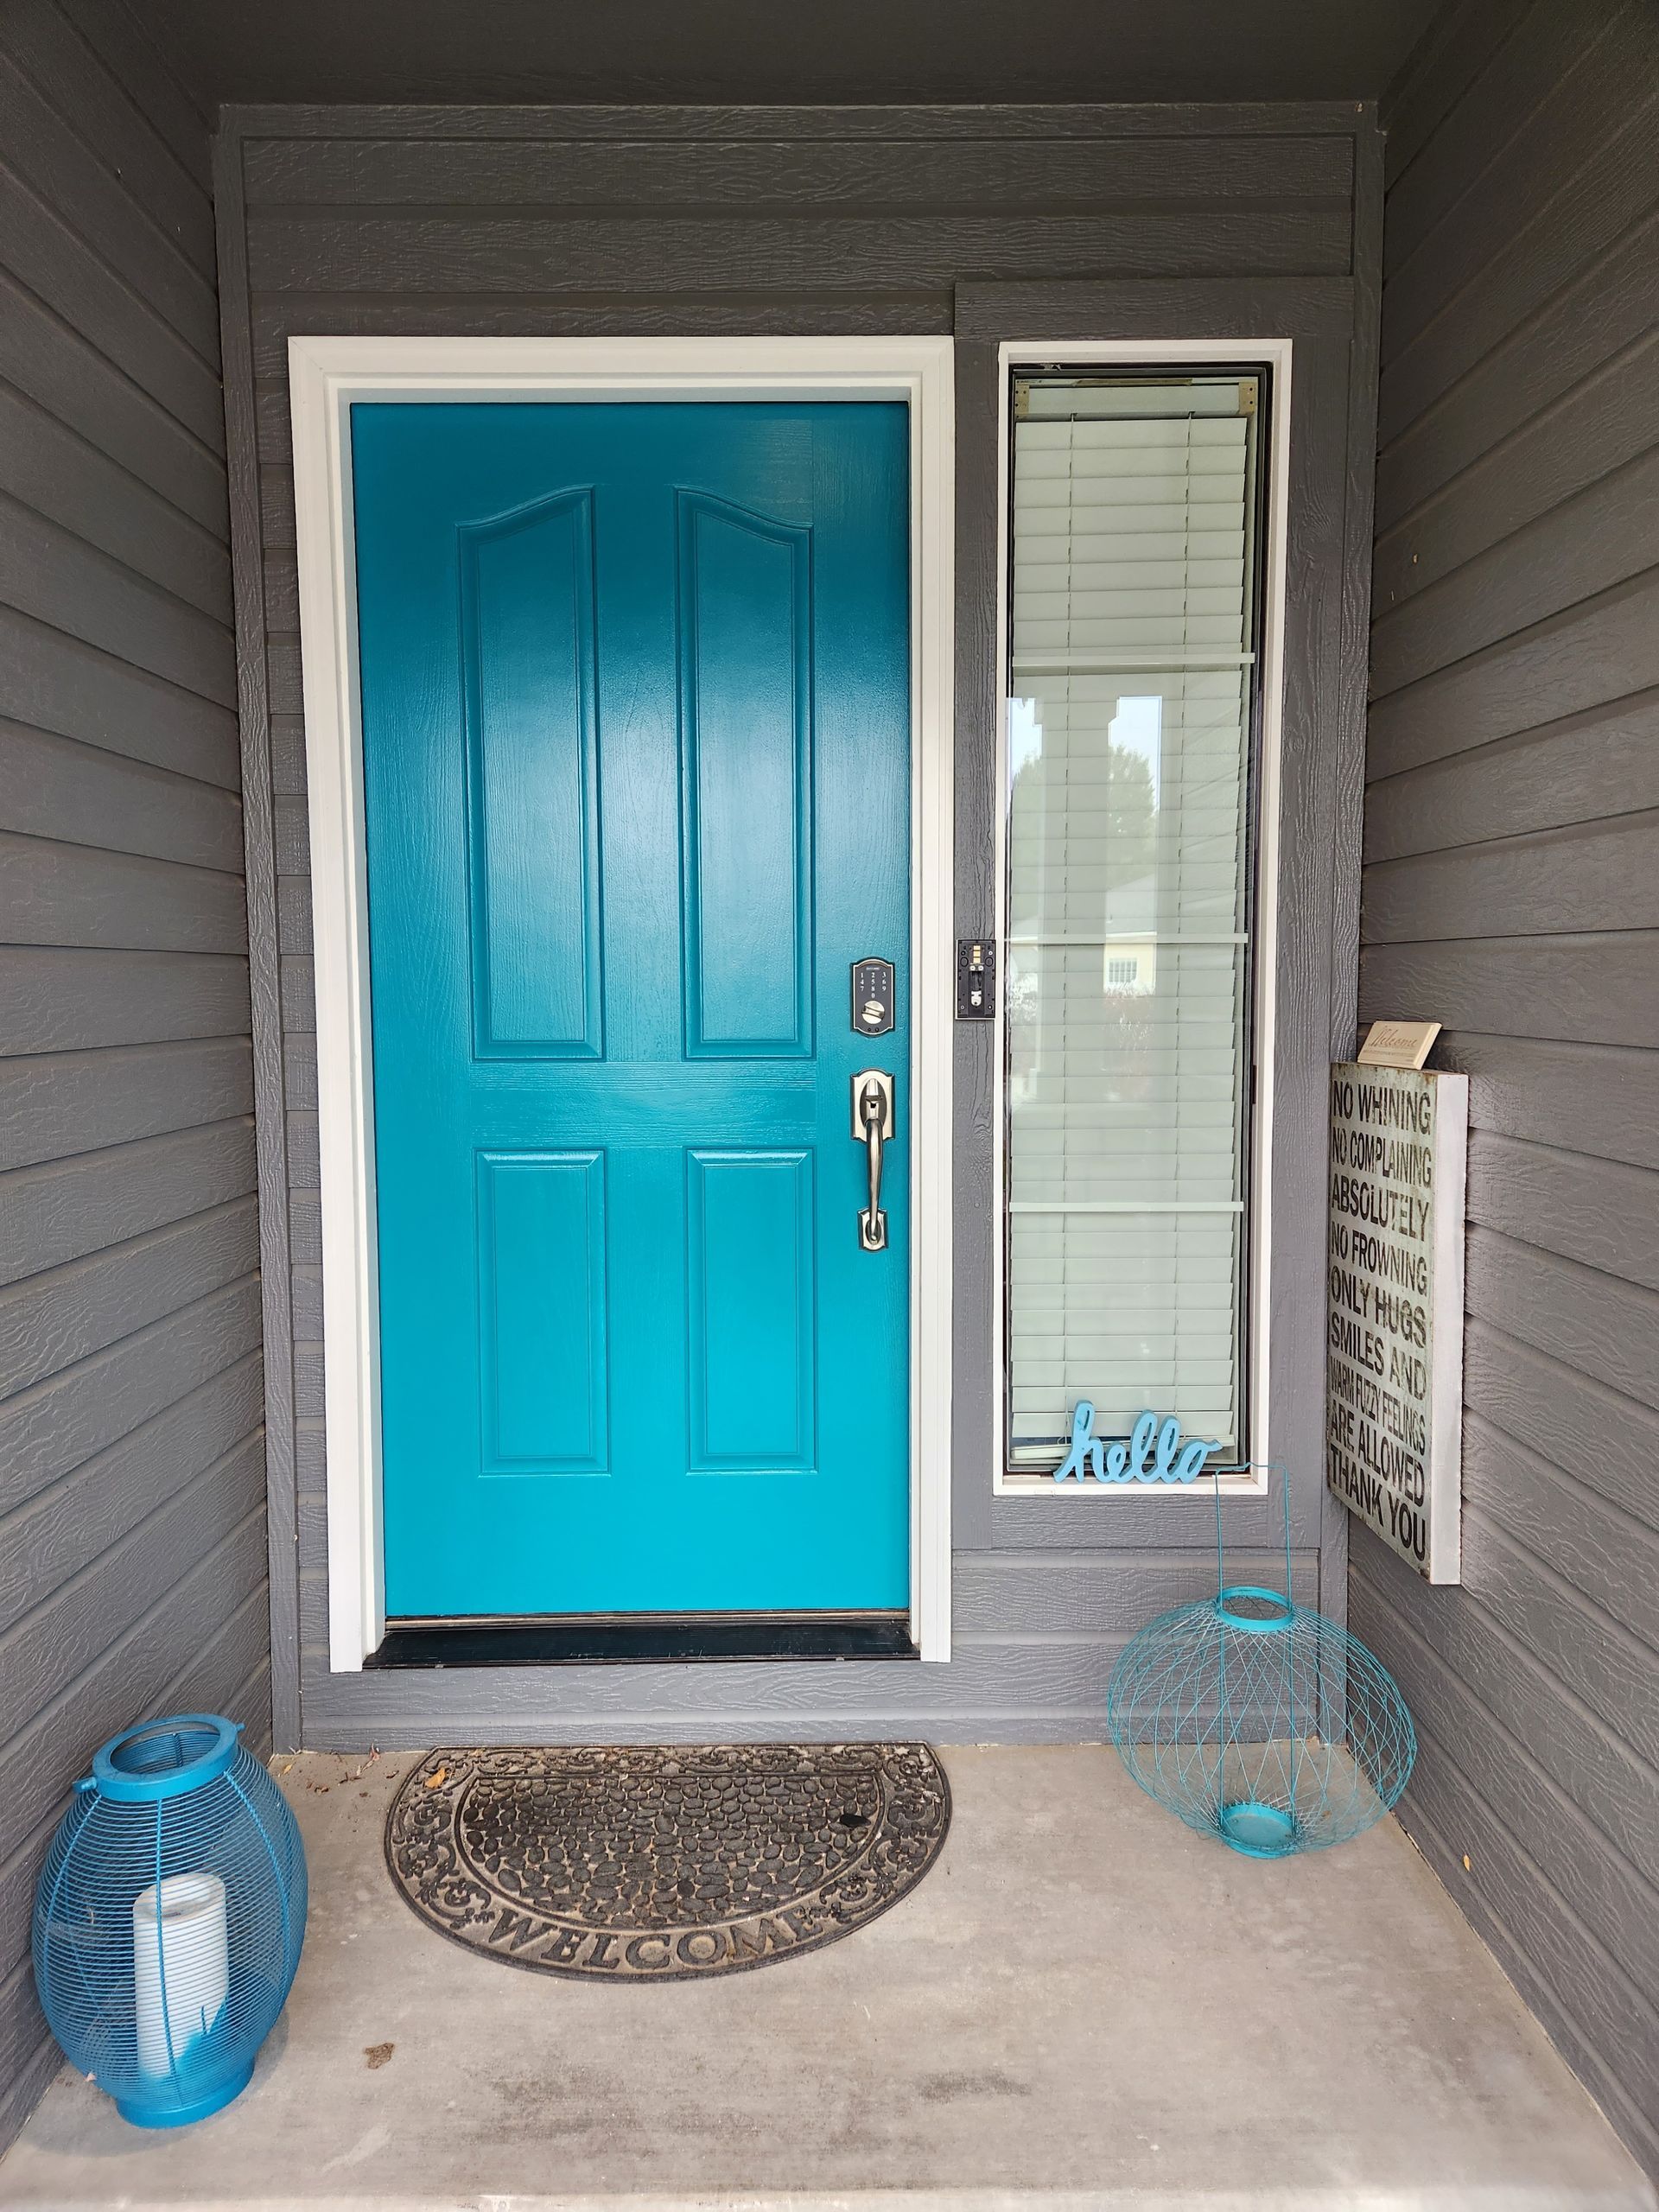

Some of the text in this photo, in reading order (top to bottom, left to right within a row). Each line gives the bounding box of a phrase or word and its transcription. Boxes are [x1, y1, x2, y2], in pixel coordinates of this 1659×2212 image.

[1370, 1026, 1418, 1048] Welcome
[1333, 1080, 1431, 1135] NO WHINING
[1332, 1126, 1432, 1189] NO COMPLAINING
[1331, 1173, 1430, 1242] ABSOLUTELY
[1332, 1221, 1427, 1297] NO FROWNING
[1331, 1265, 1427, 1349] ONLY HUGS
[1331, 1311, 1427, 1401] SMILES AND
[1053, 1400, 1224, 1484] hello
[1331, 1356, 1426, 1456] WARM FUZZY FEELINGS
[1330, 1399, 1426, 1508] ARE ALLOWED
[1330, 1443, 1427, 1562] THANK YOU
[488, 1906, 823, 1971] WELCOME
